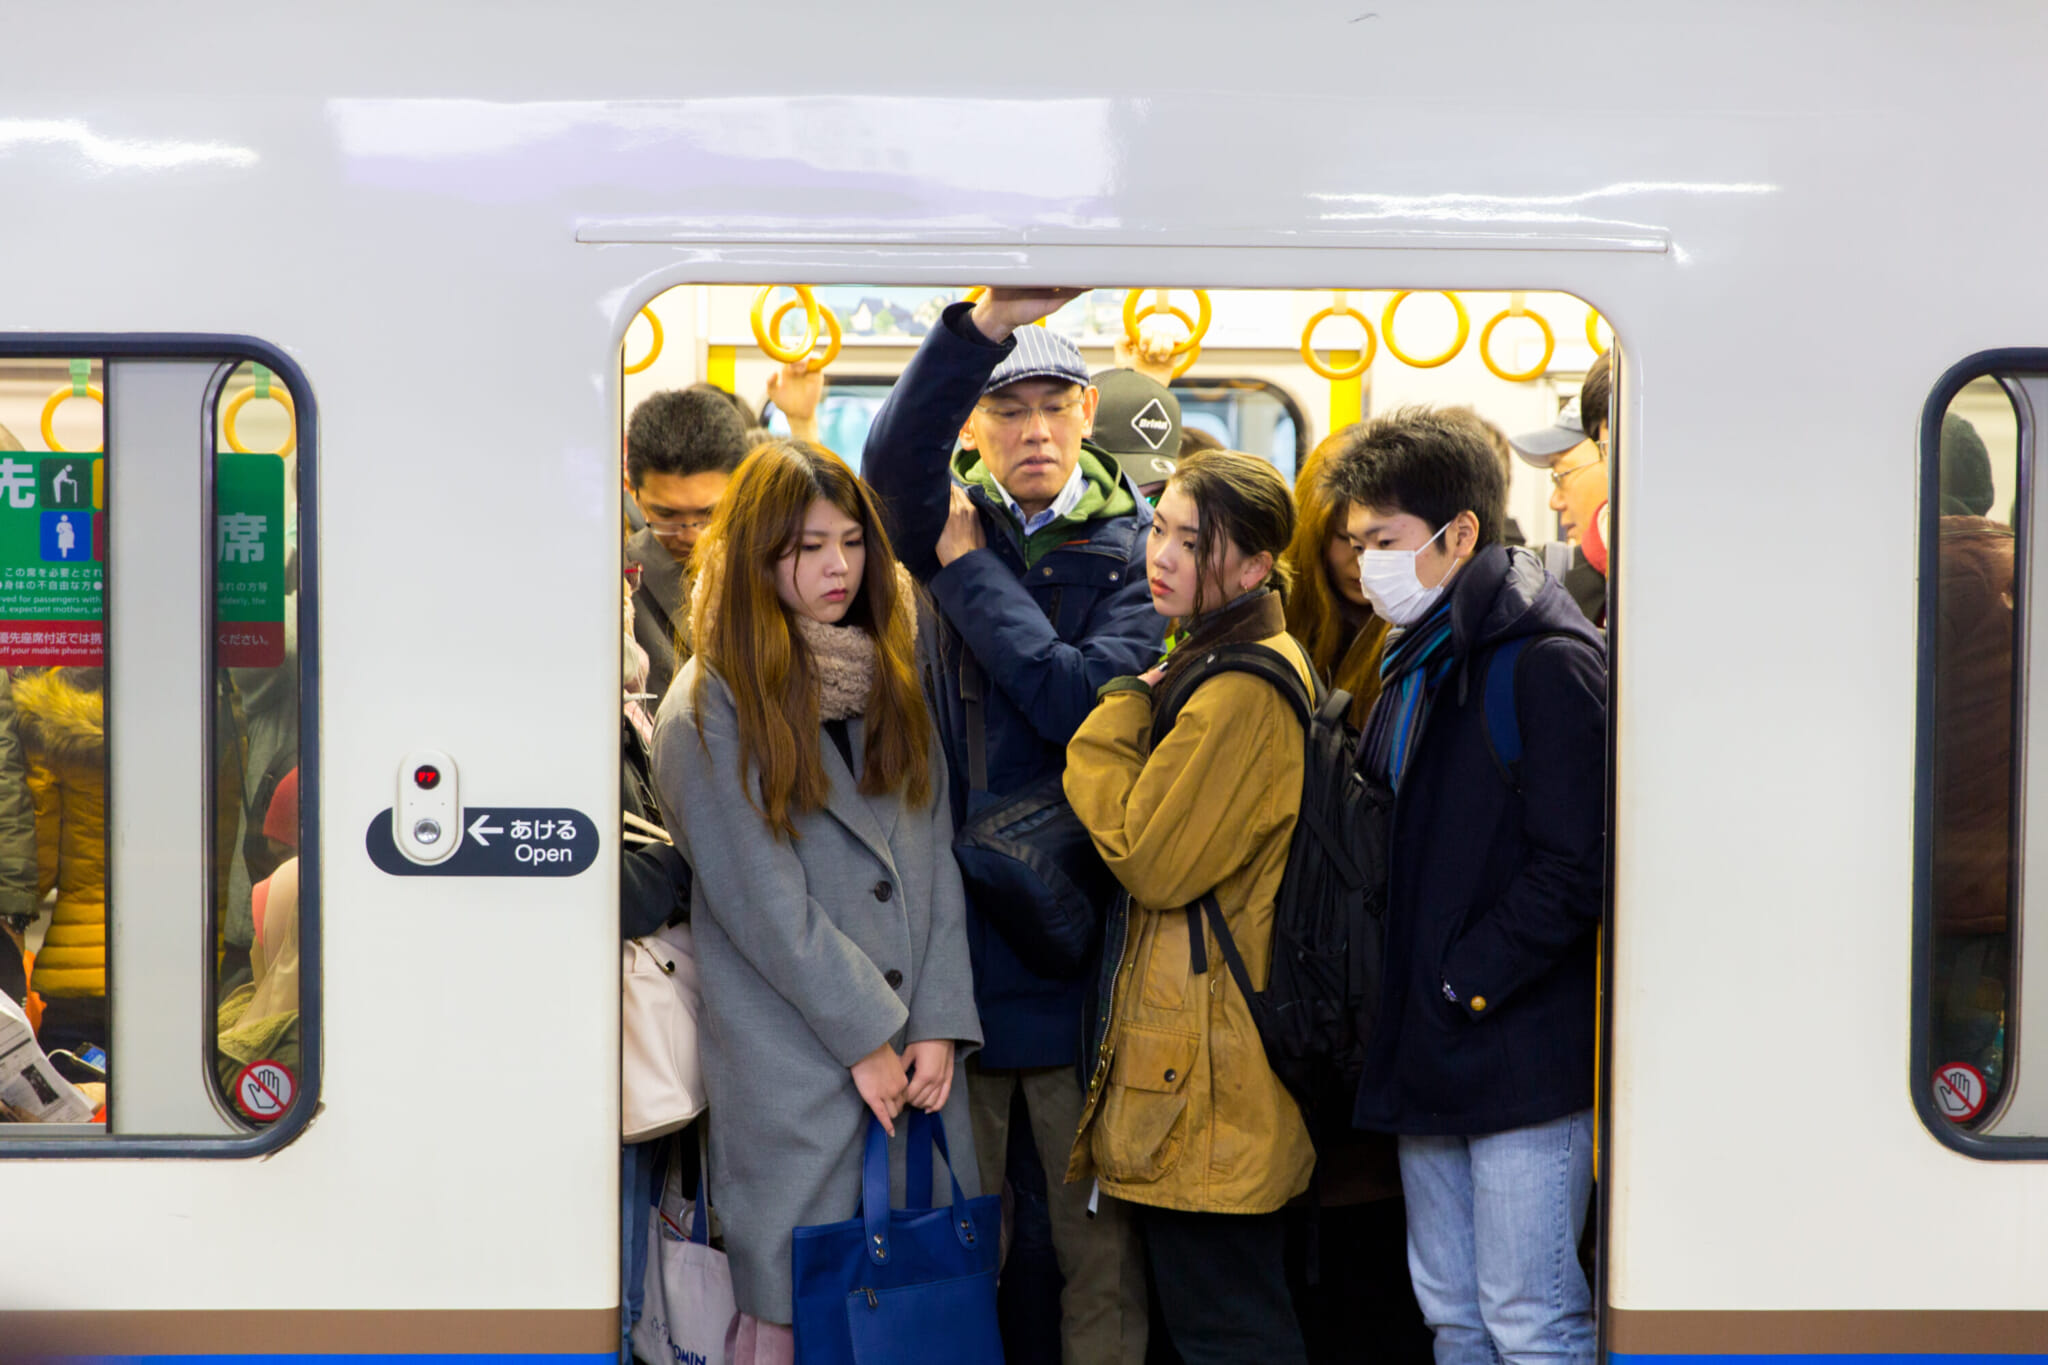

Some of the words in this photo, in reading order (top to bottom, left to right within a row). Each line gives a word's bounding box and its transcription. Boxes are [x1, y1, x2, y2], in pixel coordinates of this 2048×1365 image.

[0, 458, 36, 509] 先
[217, 512, 268, 564] 席
[31, 646, 60, 655] mobile
[510, 819, 577, 841] あける
[515, 844, 573, 866] Open
